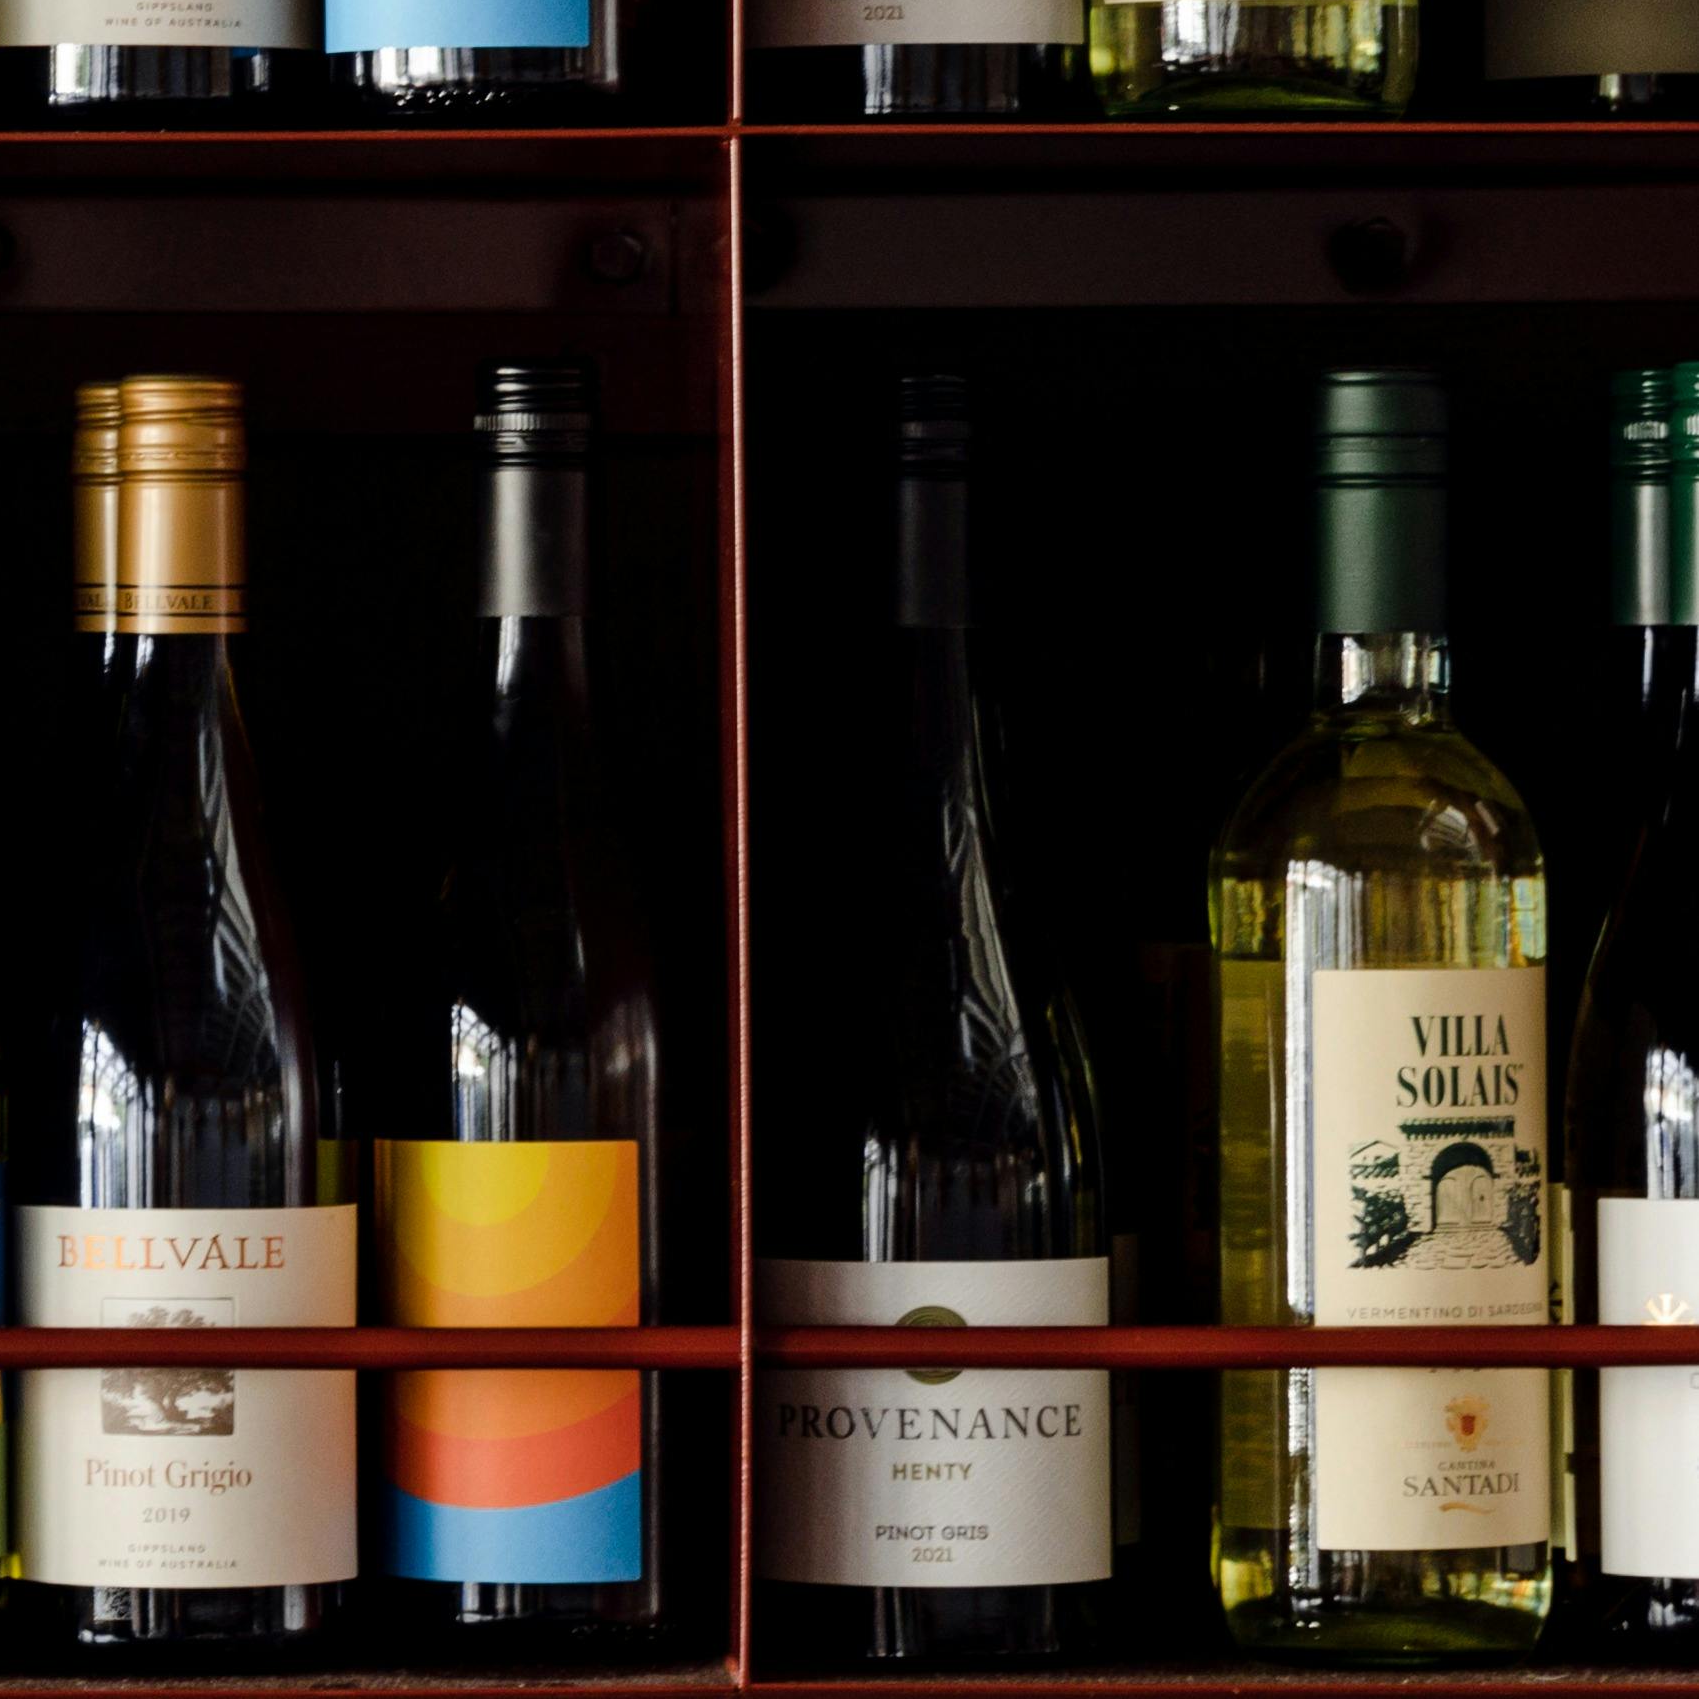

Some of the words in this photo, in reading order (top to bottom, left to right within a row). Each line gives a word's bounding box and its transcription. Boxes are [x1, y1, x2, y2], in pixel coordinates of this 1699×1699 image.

[863, 5, 906, 21] 2021
[1410, 1013, 1510, 1058] VILLA
[57, 1233, 287, 1270] BELLVALE
[1347, 1305, 1463, 1320] VERMENTINO
[1467, 1304, 1483, 1318] DI
[779, 1403, 1082, 1441] PROVENANCE
[892, 1463, 972, 1481] HENTY
[1437, 1459, 1496, 1472] CANTINA
[84, 1458, 157, 1487] Pinot
[165, 1459, 253, 1495] Grigio
[1402, 1472, 1521, 1498] SANTADI
[142, 1507, 192, 1524] 2019
[875, 1526, 933, 1541] PINOT
[941, 1525, 990, 1541] GRIS
[912, 1547, 955, 1563] 2021
[160, 1558, 238, 1570] AUSTRALIA
